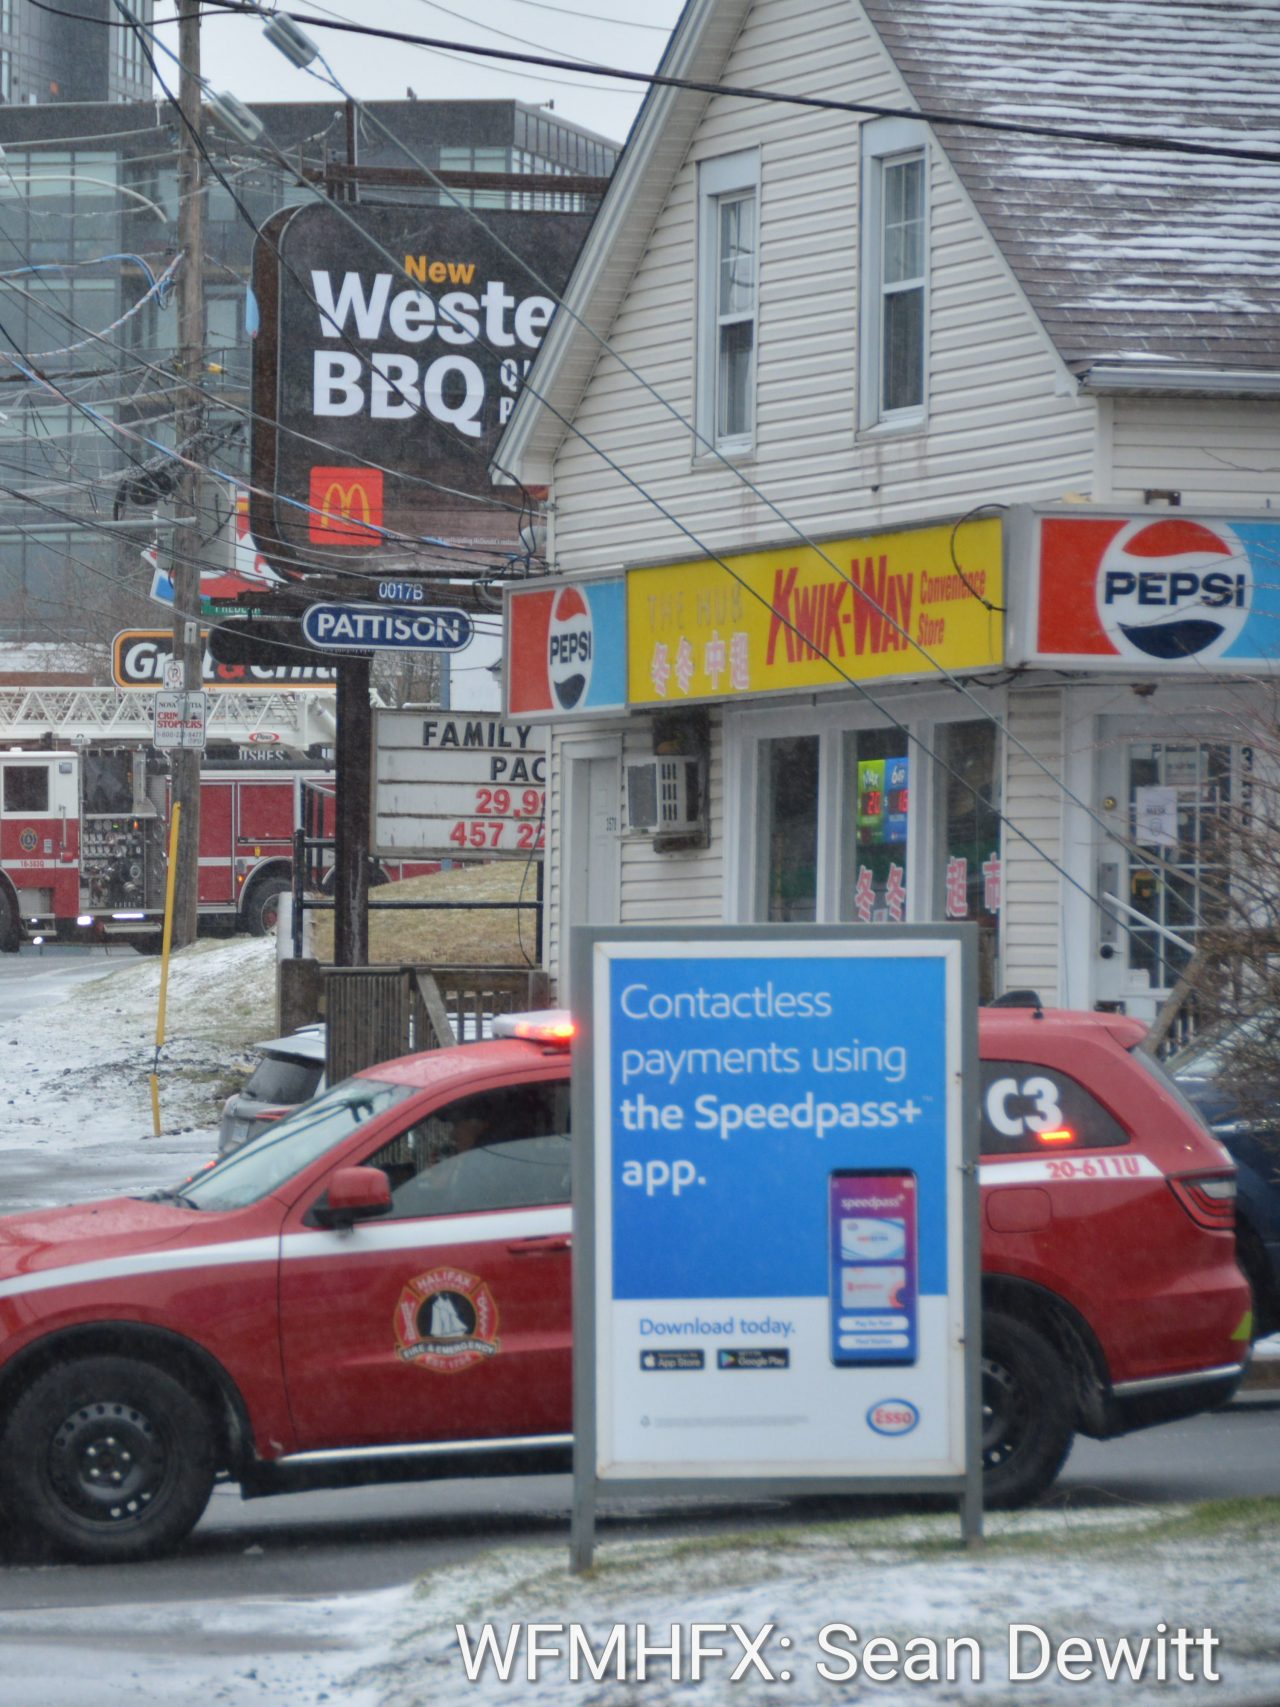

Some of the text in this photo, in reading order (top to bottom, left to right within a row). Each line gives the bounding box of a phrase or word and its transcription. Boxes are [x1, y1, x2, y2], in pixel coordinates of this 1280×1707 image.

[405, 255, 475, 284] New
[311, 270, 556, 348] Weste
[314, 350, 485, 438] BBQ
[379, 583, 423, 600] 0017B
[920, 567, 986, 604] Convenience
[1105, 572, 1246, 608] PEPSI
[317, 614, 460, 642] PATTISON
[918, 613, 945, 647] Store
[550, 631, 592, 665] PEPSI
[422, 721, 532, 748] FAMILY
[490, 757, 545, 782] PAC
[475, 789, 545, 817] 29.9
[450, 821, 504, 847] 457
[620, 981, 832, 1019] Contactless
[622, 1039, 907, 1085] payments using
[620, 1094, 683, 1130] the
[987, 1077, 1063, 1136] C3
[622, 1159, 707, 1197] app.
[1046, 1156, 1140, 1179] 20-611U
[640, 1316, 795, 1337] Download today.
[678, 1357, 701, 1367] Store
[738, 1355, 786, 1367] Google Play
